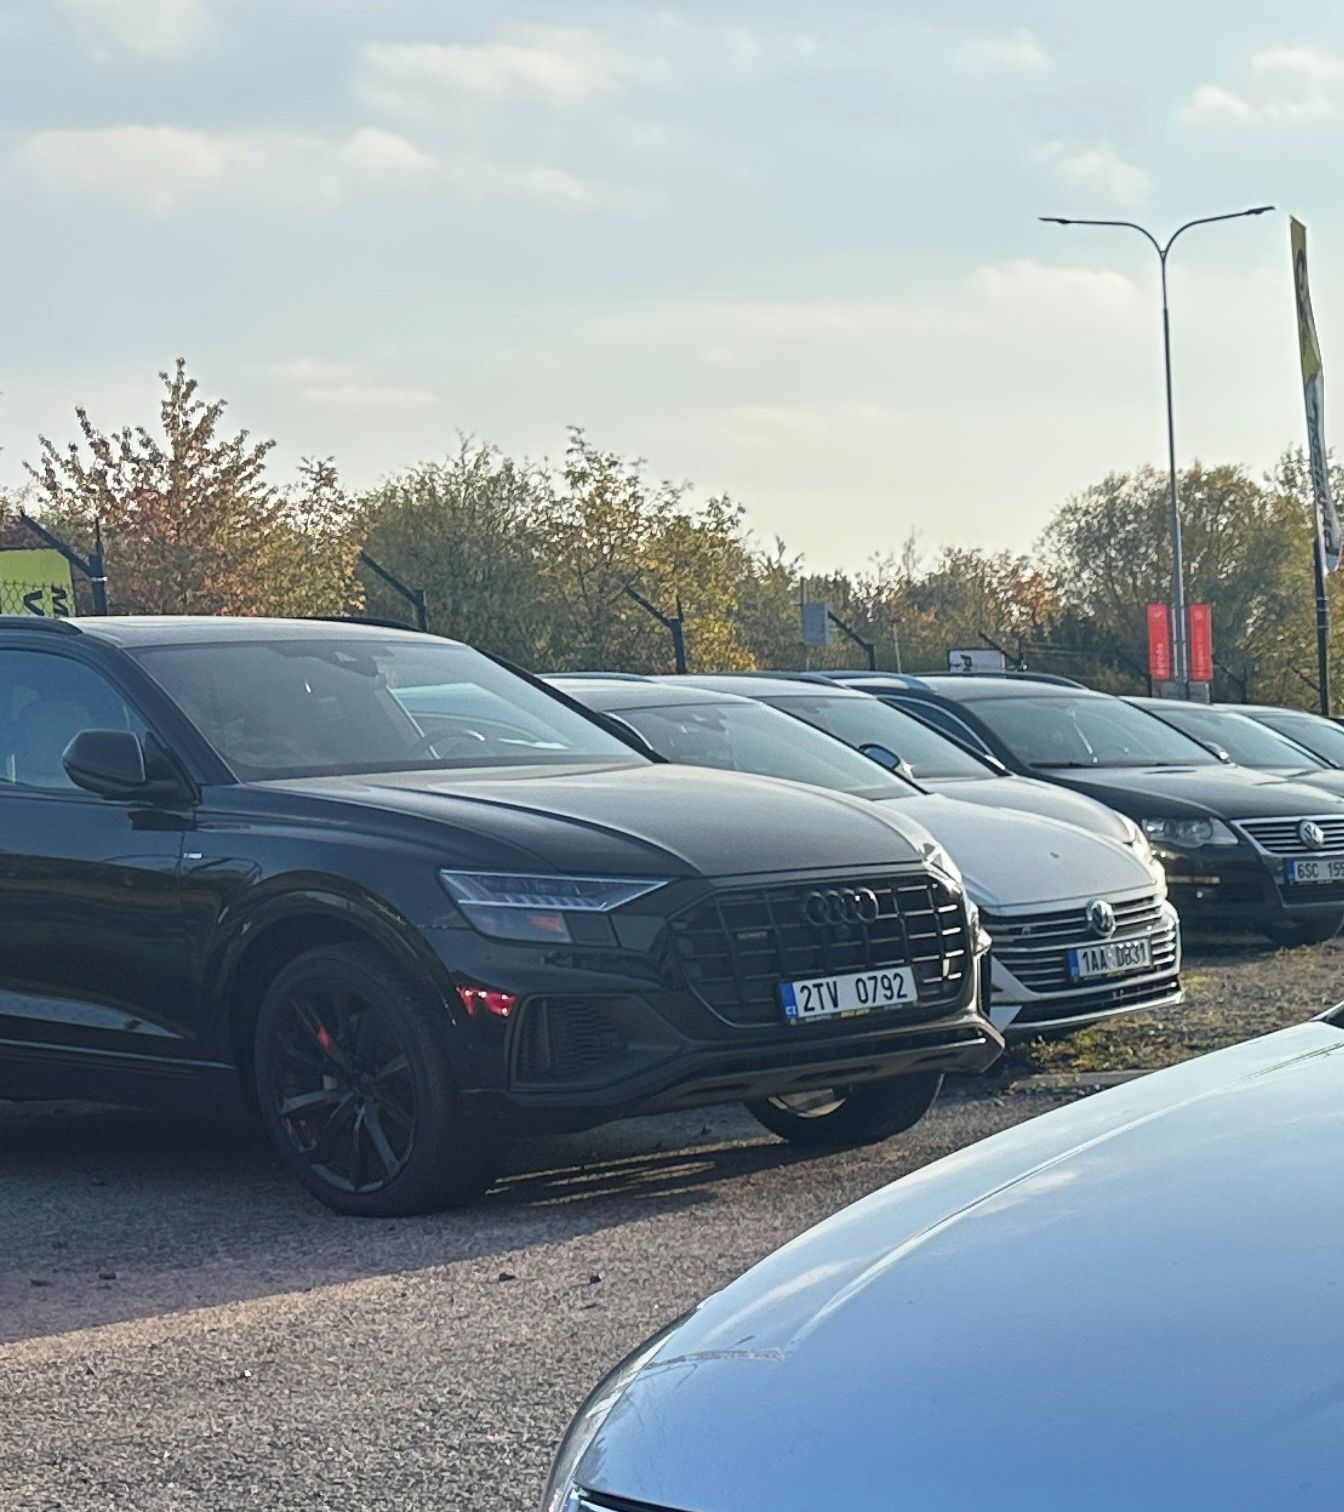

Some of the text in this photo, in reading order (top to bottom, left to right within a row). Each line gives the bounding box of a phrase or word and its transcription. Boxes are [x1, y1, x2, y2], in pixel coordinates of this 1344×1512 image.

[1297, 862, 1319, 879] 6SC
[1082, 950, 1108, 973] 1AA
[801, 981, 839, 1012] 2TV
[855, 972, 907, 1005] 0792
